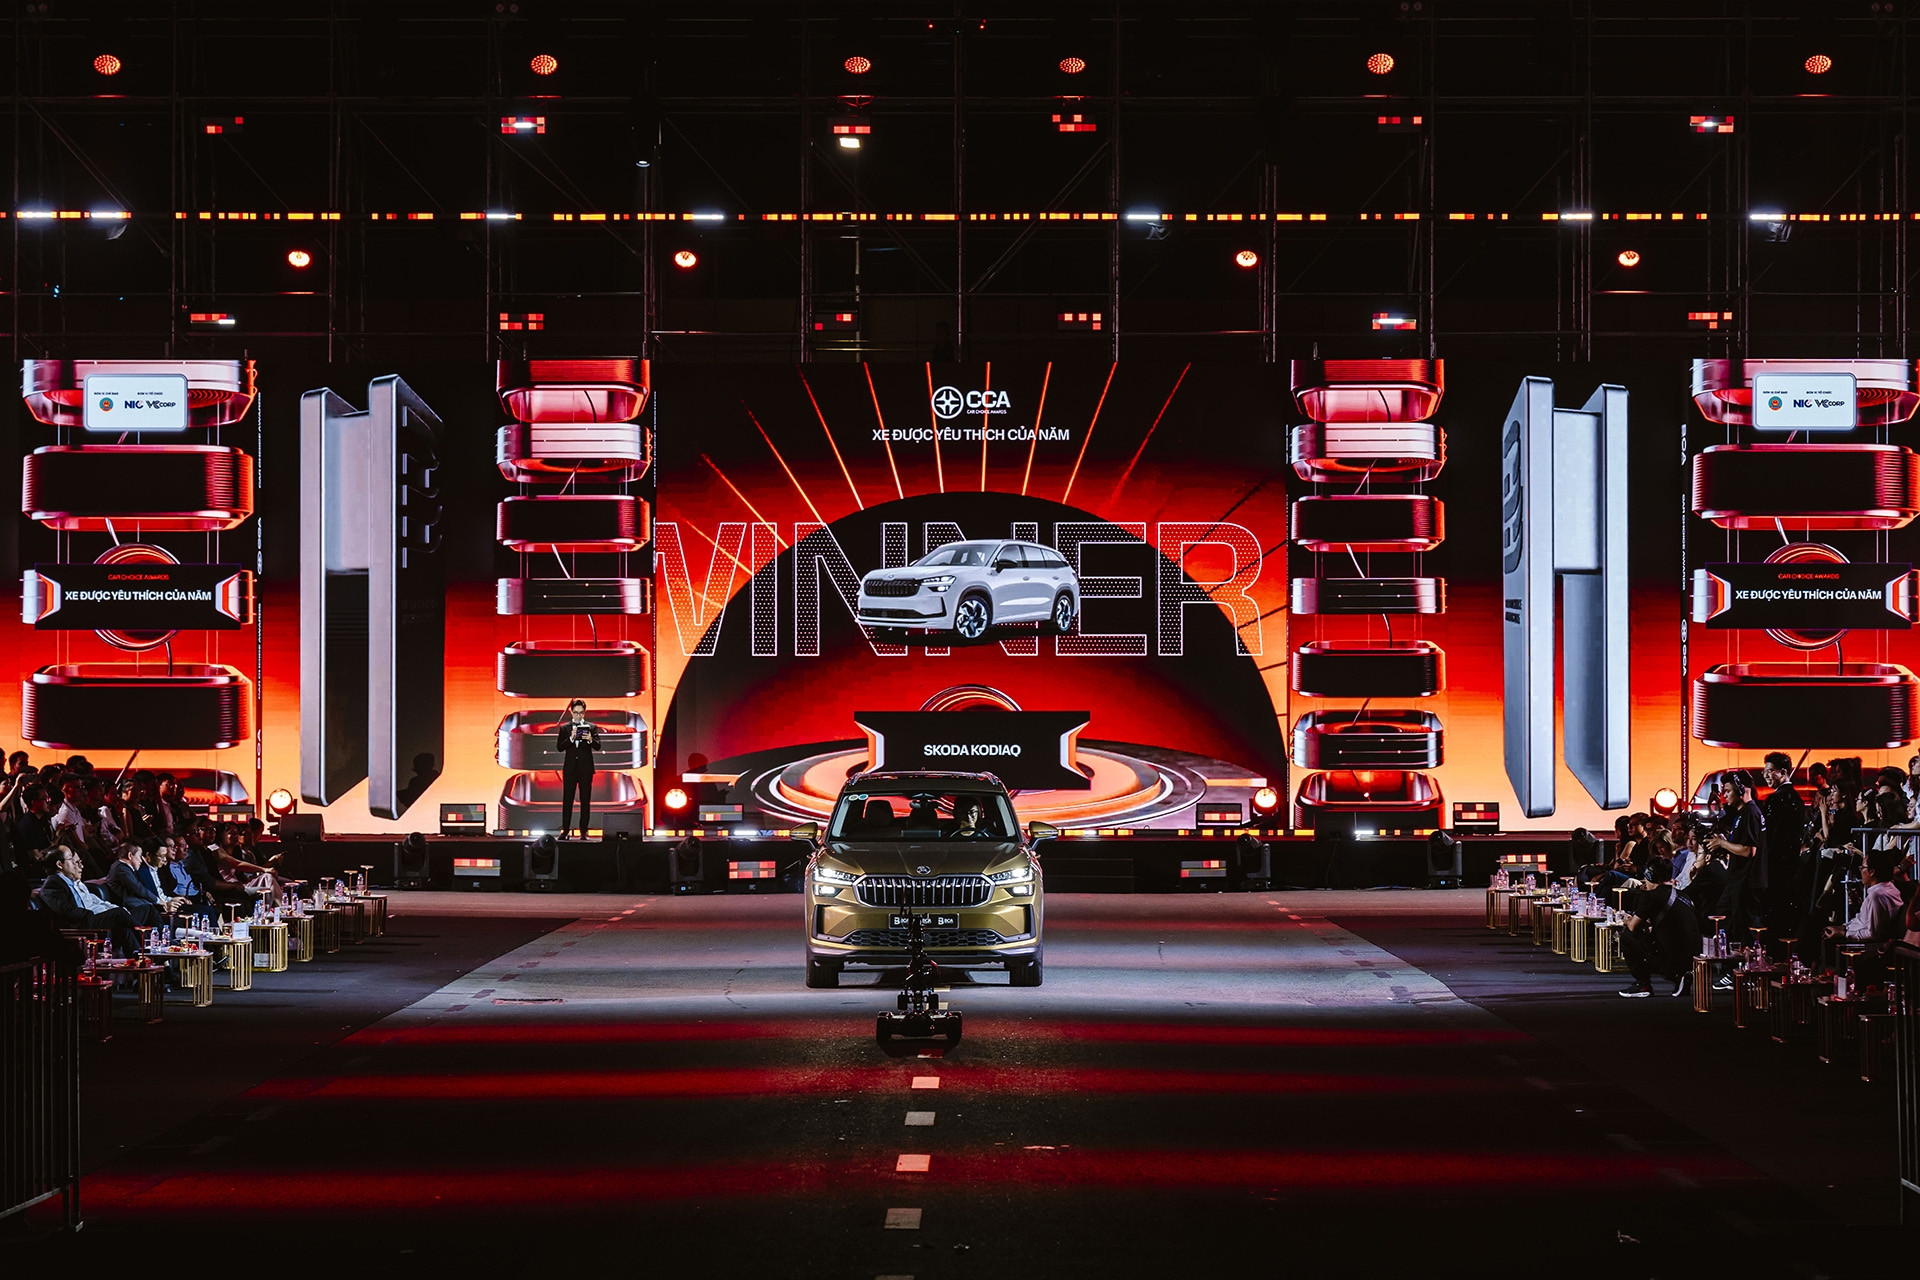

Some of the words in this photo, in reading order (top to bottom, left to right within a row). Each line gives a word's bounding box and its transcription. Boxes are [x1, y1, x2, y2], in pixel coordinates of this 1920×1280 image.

[966, 390, 1011, 409] CCA
[872, 429, 890, 441] XE
[891, 428, 934, 444] ĐƯỢC
[935, 426, 962, 441] YÊU
[963, 426, 1005, 441] THÍCH
[1007, 425, 1037, 441] CỦA
[1038, 426, 1070, 441] NĂM
[65, 591, 79, 600] XE
[79, 590, 111, 602] ĐƯỢC
[111, 589, 132, 600] YÊU
[132, 589, 163, 600] THÍCH
[164, 588, 187, 600] CỦA
[187, 589, 212, 600] NĂM
[1735, 590, 1749, 599] XE
[1750, 589, 1781, 601] ĐƯỢC
[1781, 588, 1802, 599] YÊU
[1802, 588, 1834, 599] THÍCH
[1834, 587, 1857, 599] CỦA
[1857, 588, 1882, 599] NĂM
[923, 744, 969, 756] SKODA
[970, 744, 1021, 758] KODIAQ
